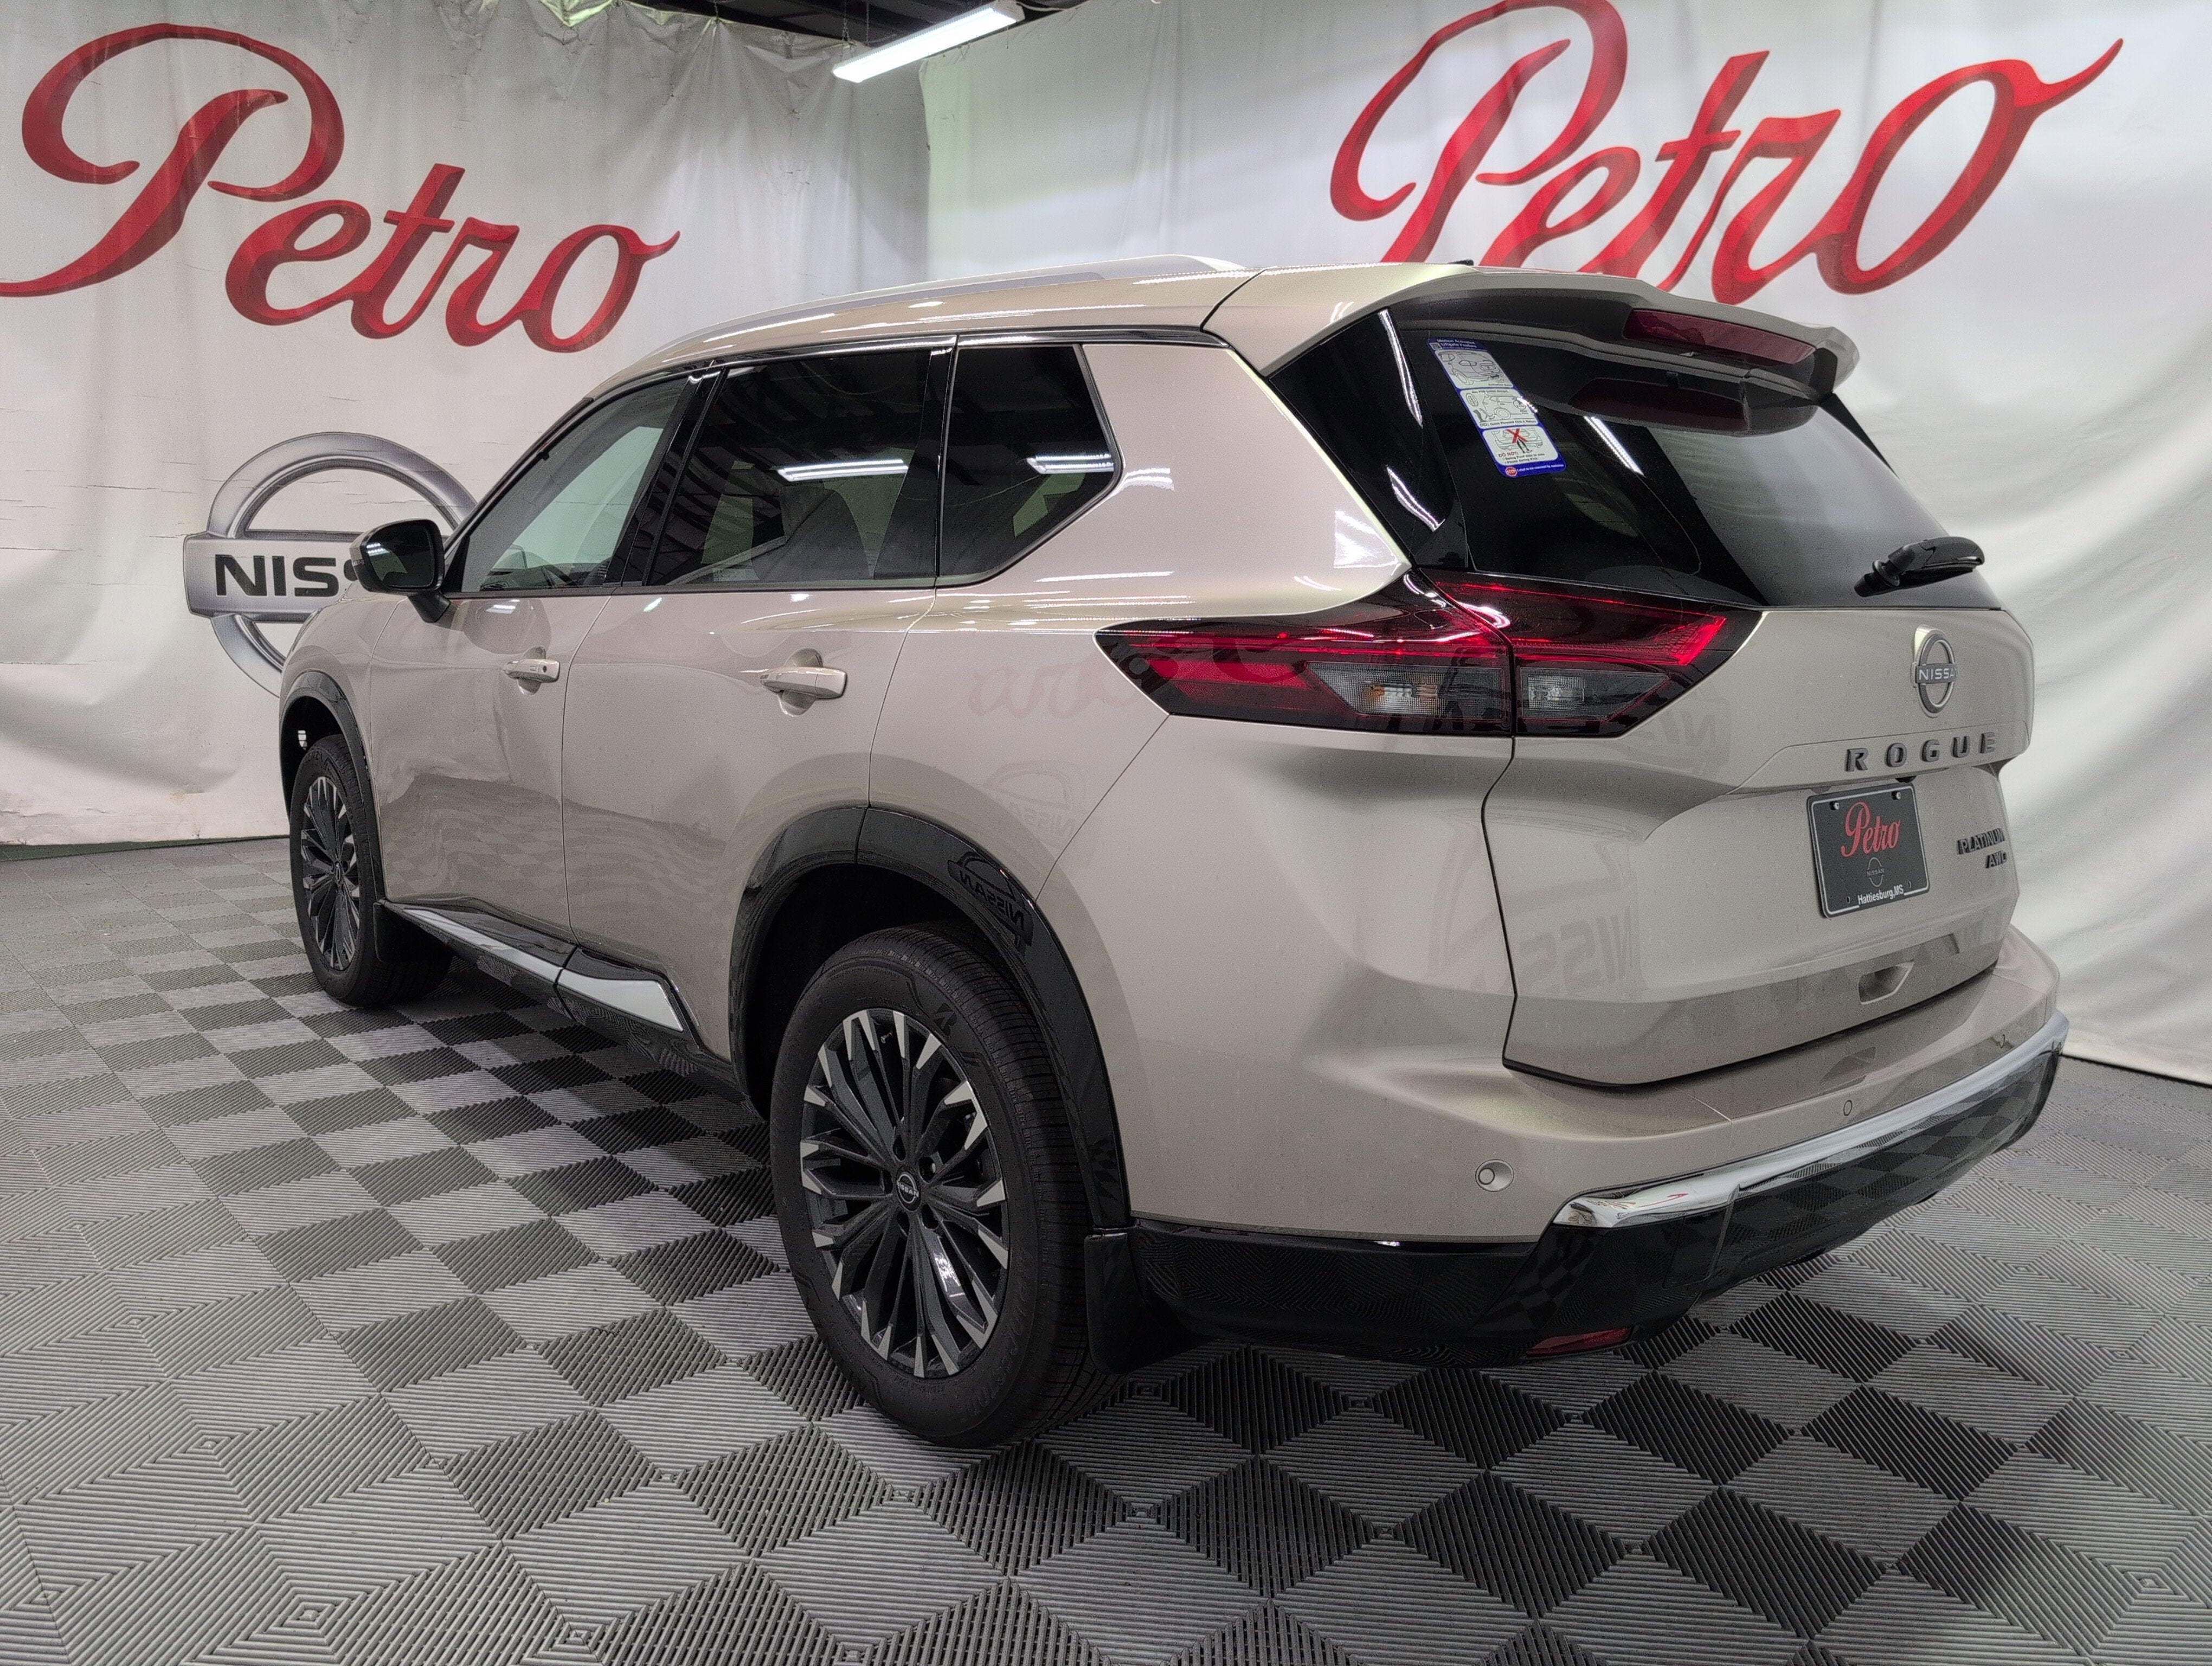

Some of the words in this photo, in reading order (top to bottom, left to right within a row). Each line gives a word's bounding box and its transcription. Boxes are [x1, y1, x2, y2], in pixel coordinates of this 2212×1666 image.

[1329, 0, 2123, 305] Petro
[0, 23, 680, 353] Petro
[215, 554, 358, 597] NIS
[1846, 732, 1996, 772] ROGUE
[1841, 801, 1900, 857] Petro
[1957, 828, 2005, 855] PLATINUM
[1867, 868, 1884, 877] NISSAN
[1985, 850, 2007, 868] AWD
